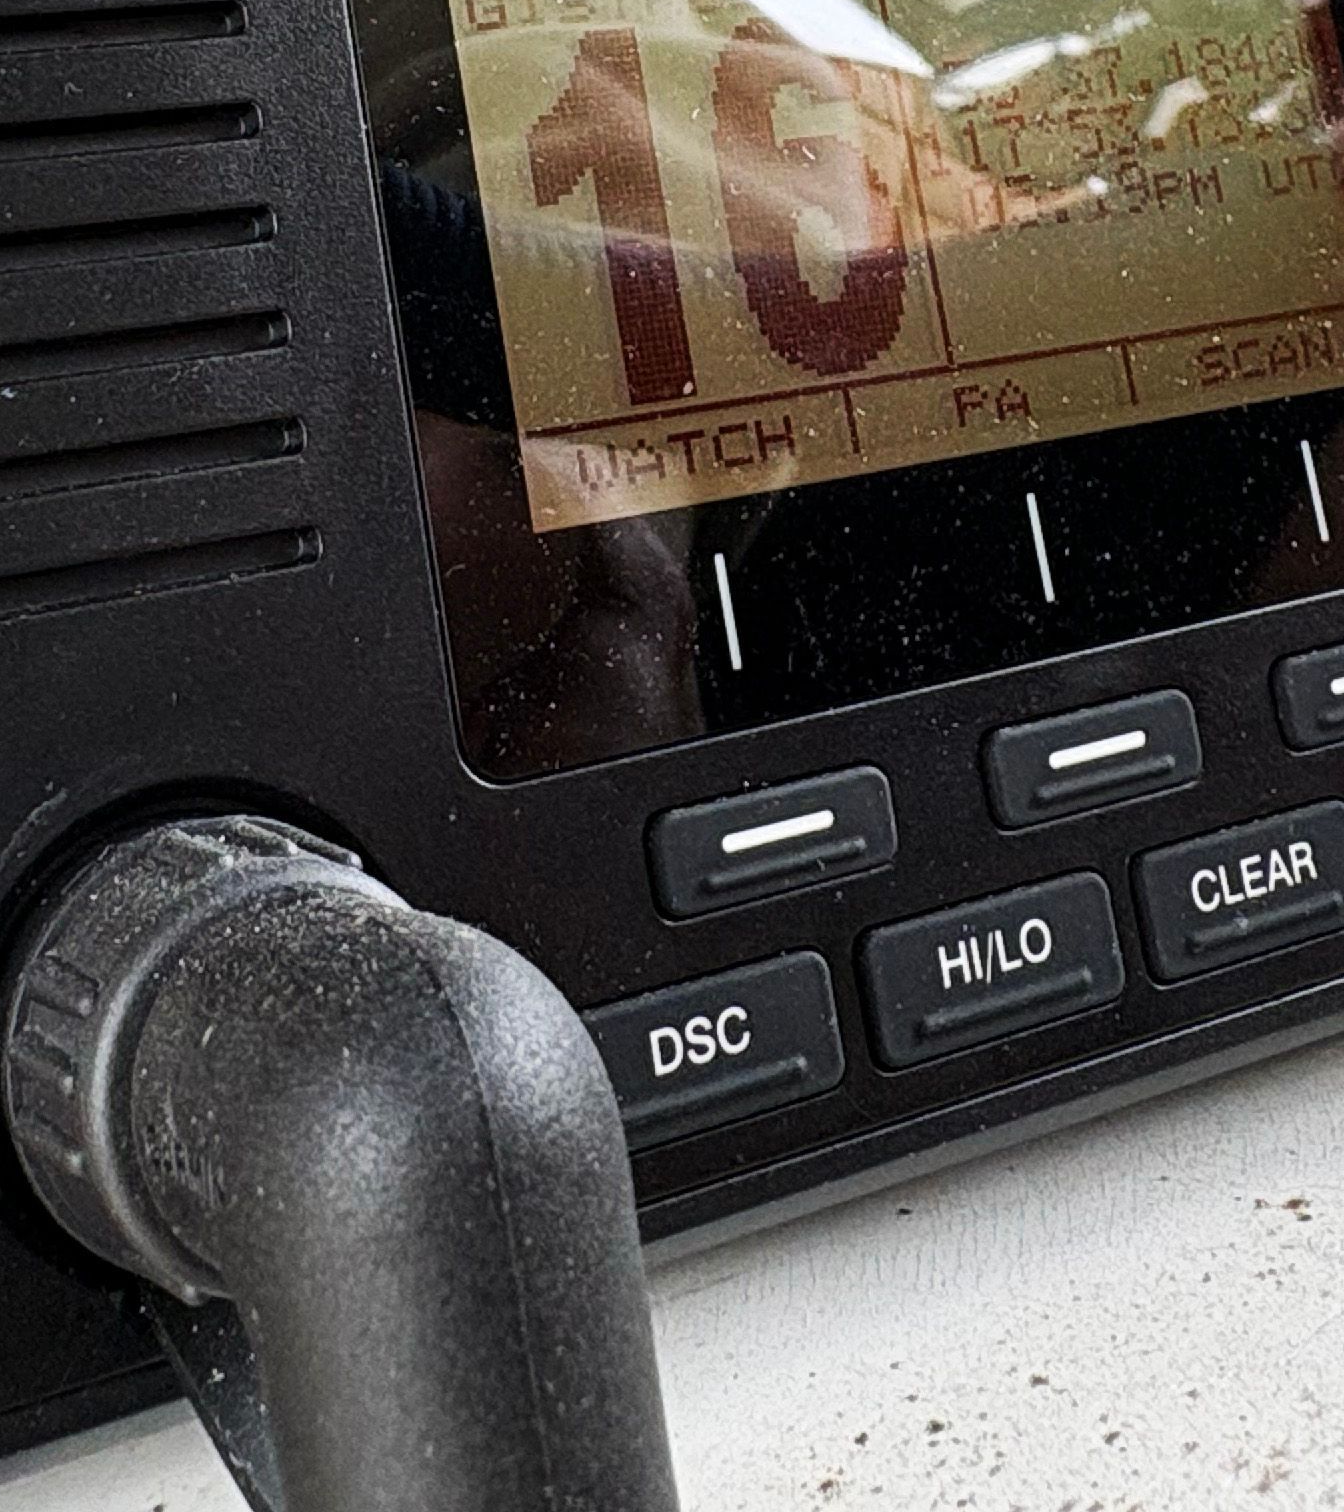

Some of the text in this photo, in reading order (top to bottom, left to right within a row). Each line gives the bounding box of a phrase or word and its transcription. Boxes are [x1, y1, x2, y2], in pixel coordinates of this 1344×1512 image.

[527, 16, 910, 406] 16
[1197, 331, 1340, 388] SCAN
[953, 377, 1034, 428] PA
[576, 415, 797, 490] WATCH
[1190, 841, 1319, 914] CLEAR
[937, 915, 1054, 990] HI/LO
[649, 1004, 752, 1078] DSC
